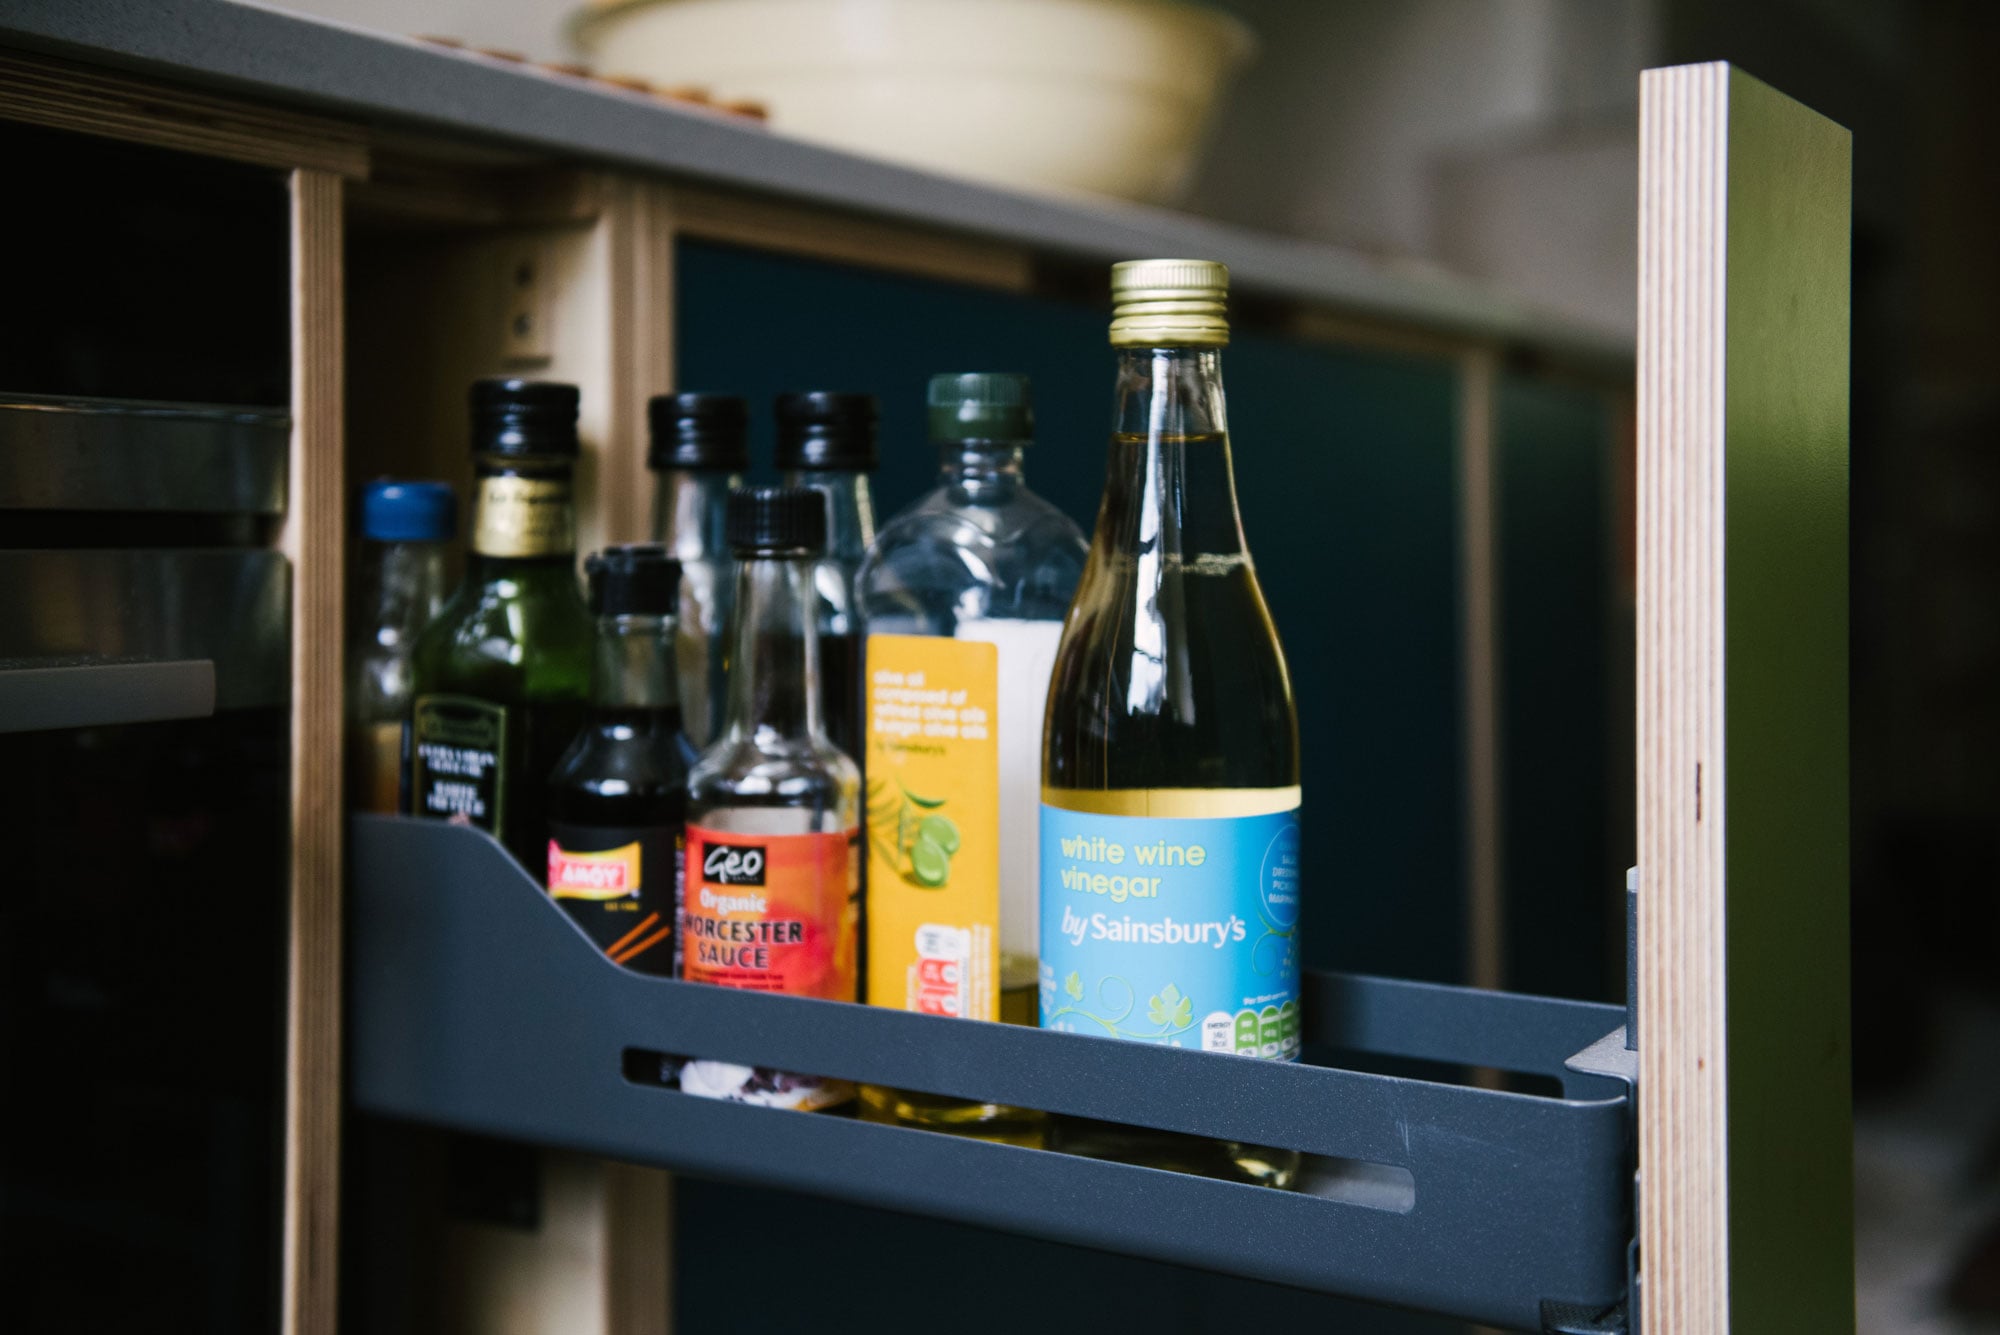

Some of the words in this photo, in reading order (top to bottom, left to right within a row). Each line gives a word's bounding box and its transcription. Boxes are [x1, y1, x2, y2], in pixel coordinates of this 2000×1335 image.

[907, 671, 924, 687] oil
[951, 690, 967, 706] of
[923, 707, 957, 721] olive
[924, 722, 958, 738] olive
[1060, 834, 1125, 864] white
[1134, 840, 1206, 867] wine
[703, 846, 763, 884] Geo
[1060, 866, 1161, 903] vinegar
[700, 887, 767, 916] Organic
[1060, 905, 1087, 946] by
[1091, 912, 1246, 949] Sainsbury's
[698, 942, 768, 968] SAUCE
